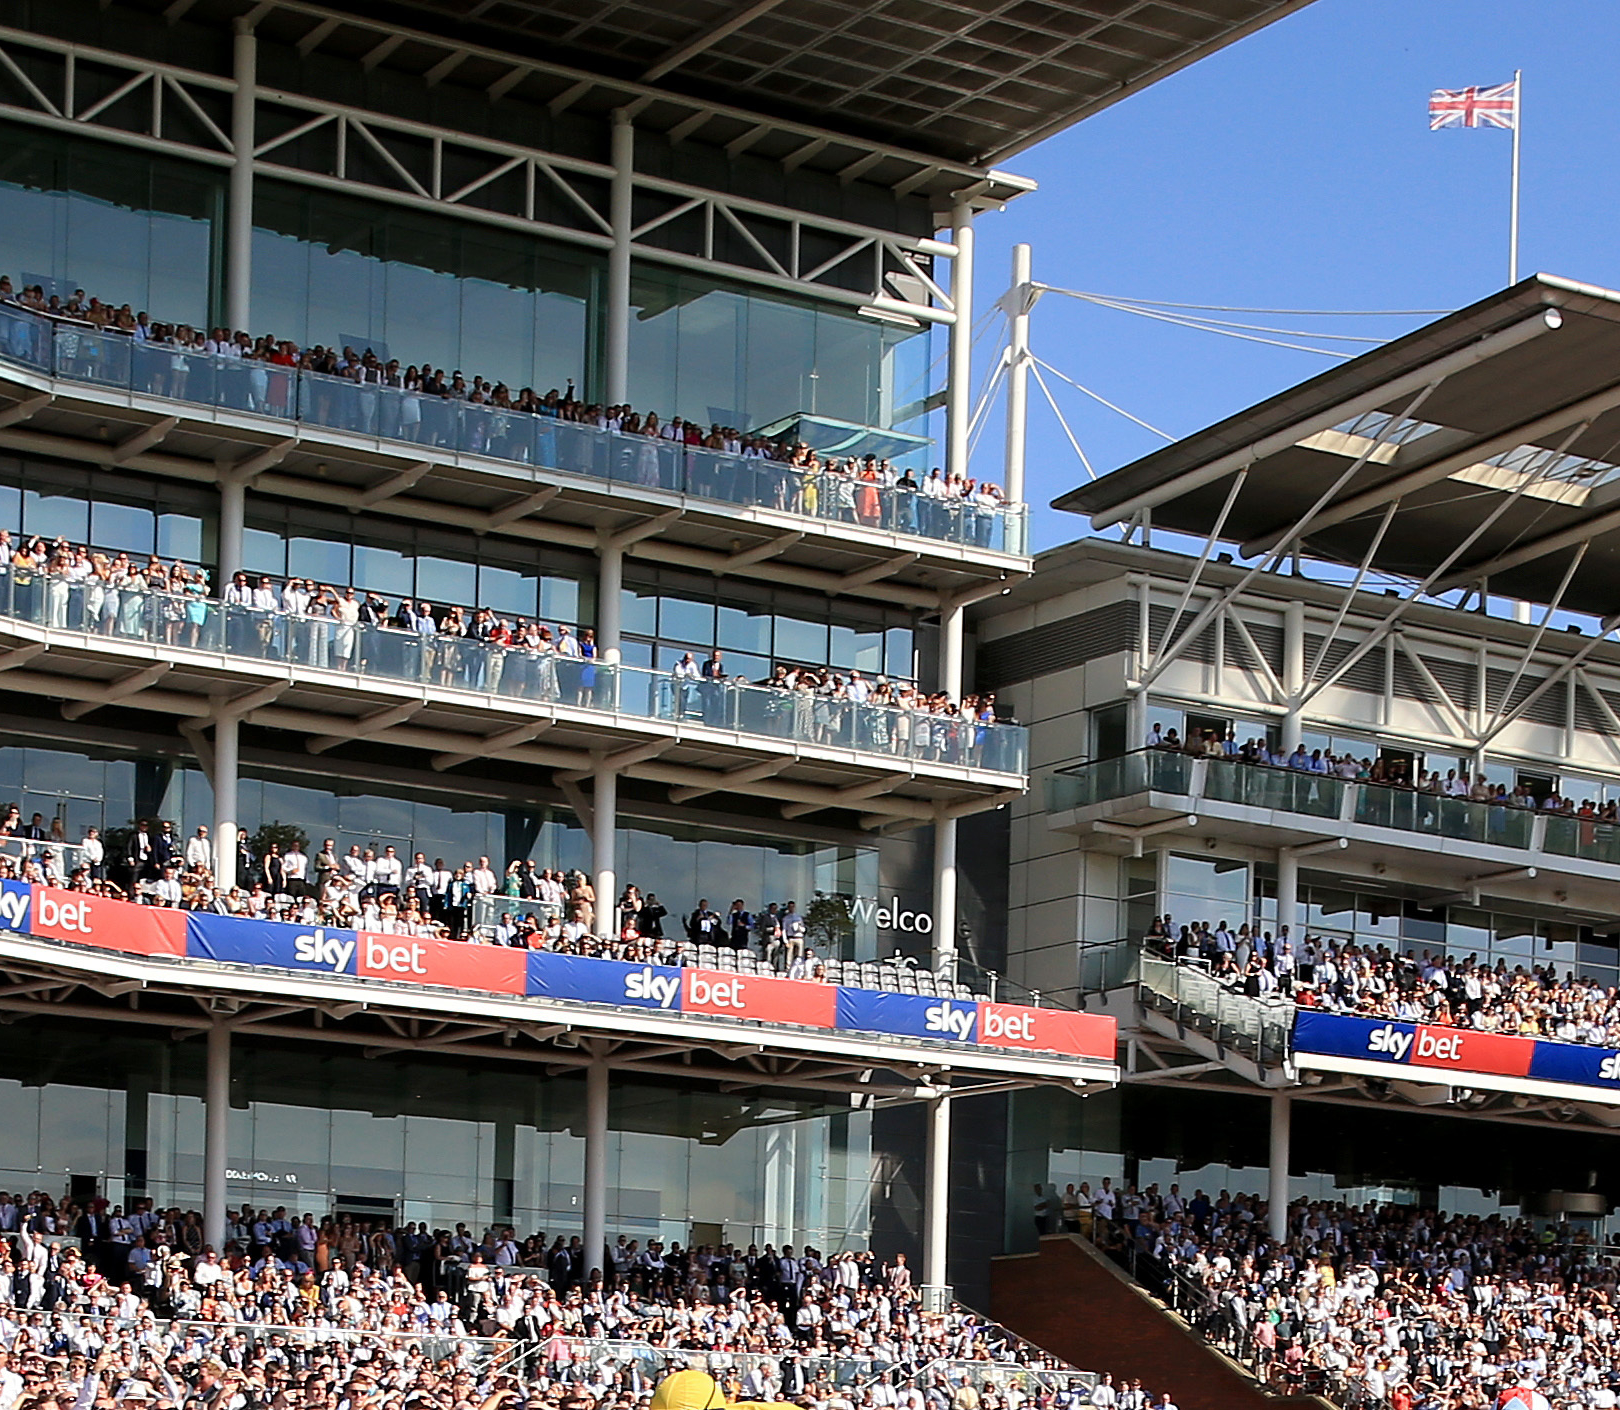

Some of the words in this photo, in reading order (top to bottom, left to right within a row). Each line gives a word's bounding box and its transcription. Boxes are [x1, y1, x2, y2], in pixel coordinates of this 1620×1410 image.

[39, 890, 92, 933] bet
[294, 929, 356, 973] sky
[366, 936, 427, 974] bet
[625, 966, 681, 1009] sky
[690, 972, 746, 1009] bet
[925, 1001, 977, 1041] sky
[984, 1006, 1036, 1041] bet
[1367, 1024, 1415, 1060] sky
[1417, 1028, 1464, 1060] bet
